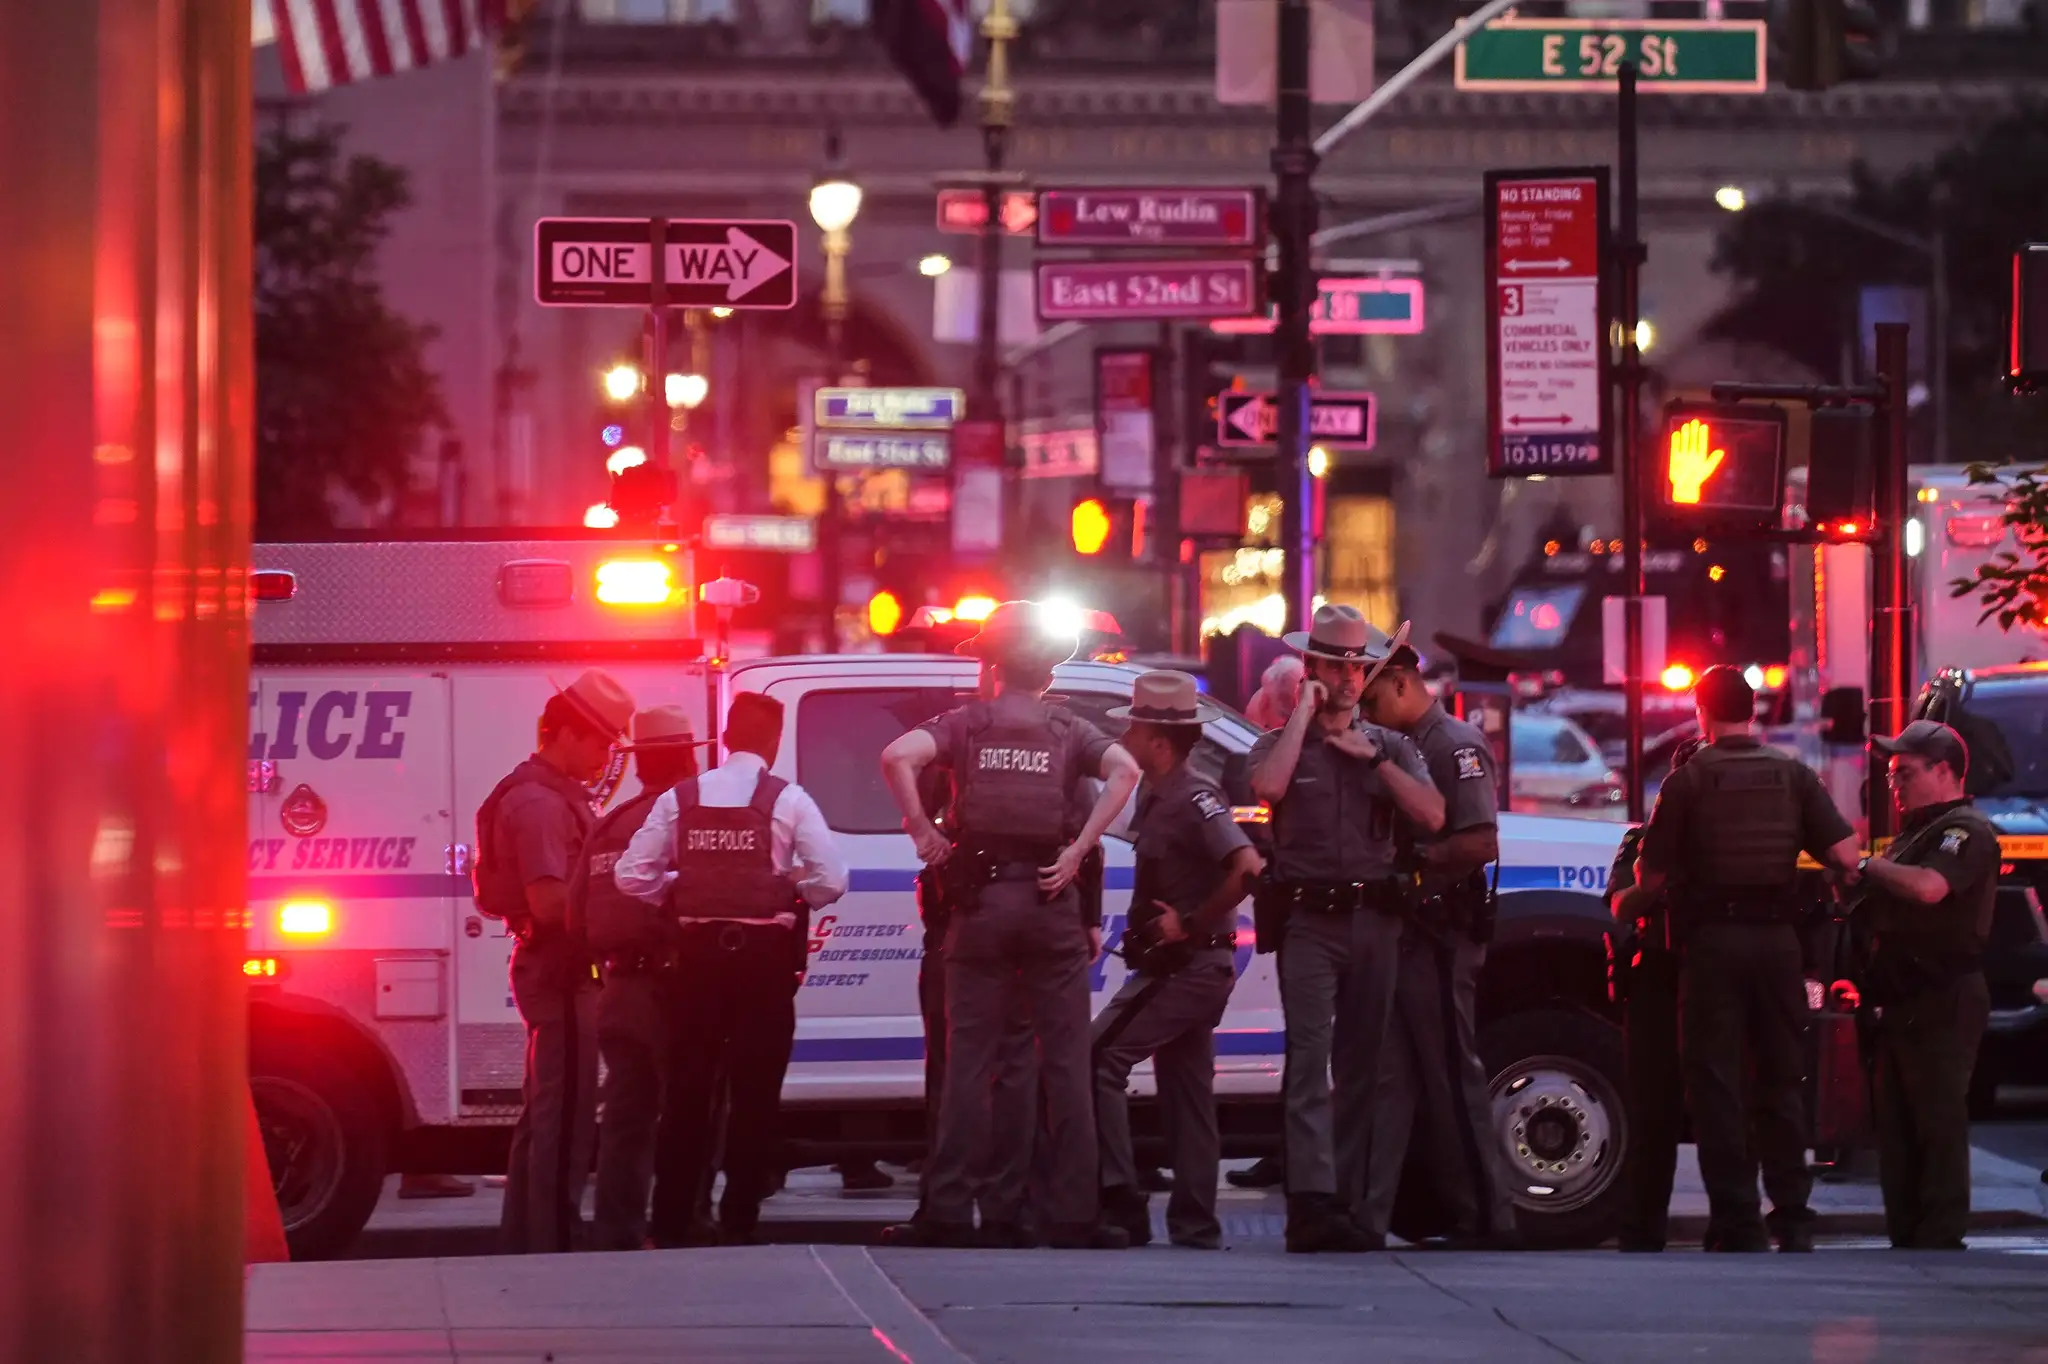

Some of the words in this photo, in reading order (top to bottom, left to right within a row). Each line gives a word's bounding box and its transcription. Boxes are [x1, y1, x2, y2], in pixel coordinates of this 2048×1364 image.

[1542, 34, 1566, 76] E
[1579, 34, 1627, 76] 52
[1639, 34, 1679, 77] St
[1500, 187, 1518, 203] NO
[1520, 187, 1582, 203] STANDING
[1075, 196, 1130, 223] Lew
[1138, 196, 1218, 223] Rudin
[1128, 221, 1166, 241] Way
[561, 246, 635, 279] ONE
[679, 248, 760, 280] WAY
[1052, 276, 1118, 307] East
[1126, 274, 1200, 306] 52nd
[1208, 273, 1241, 304] St
[1503, 287, 1519, 316] 3
[1504, 323, 1578, 338] COMMERCIAL
[1504, 340, 1559, 353] VEHICLES
[1561, 339, 1591, 353] ONLY
[1504, 443, 1577, 465] 103159
[979, 747, 1011, 770] STATE
[1011, 749, 1050, 773] POLICE
[687, 829, 718, 851] STATE
[719, 829, 755, 851] POLICE
[292, 837, 417, 870] SERVICE
[815, 915, 909, 938] COURTESY
[798, 973, 869, 988] ESPECT
